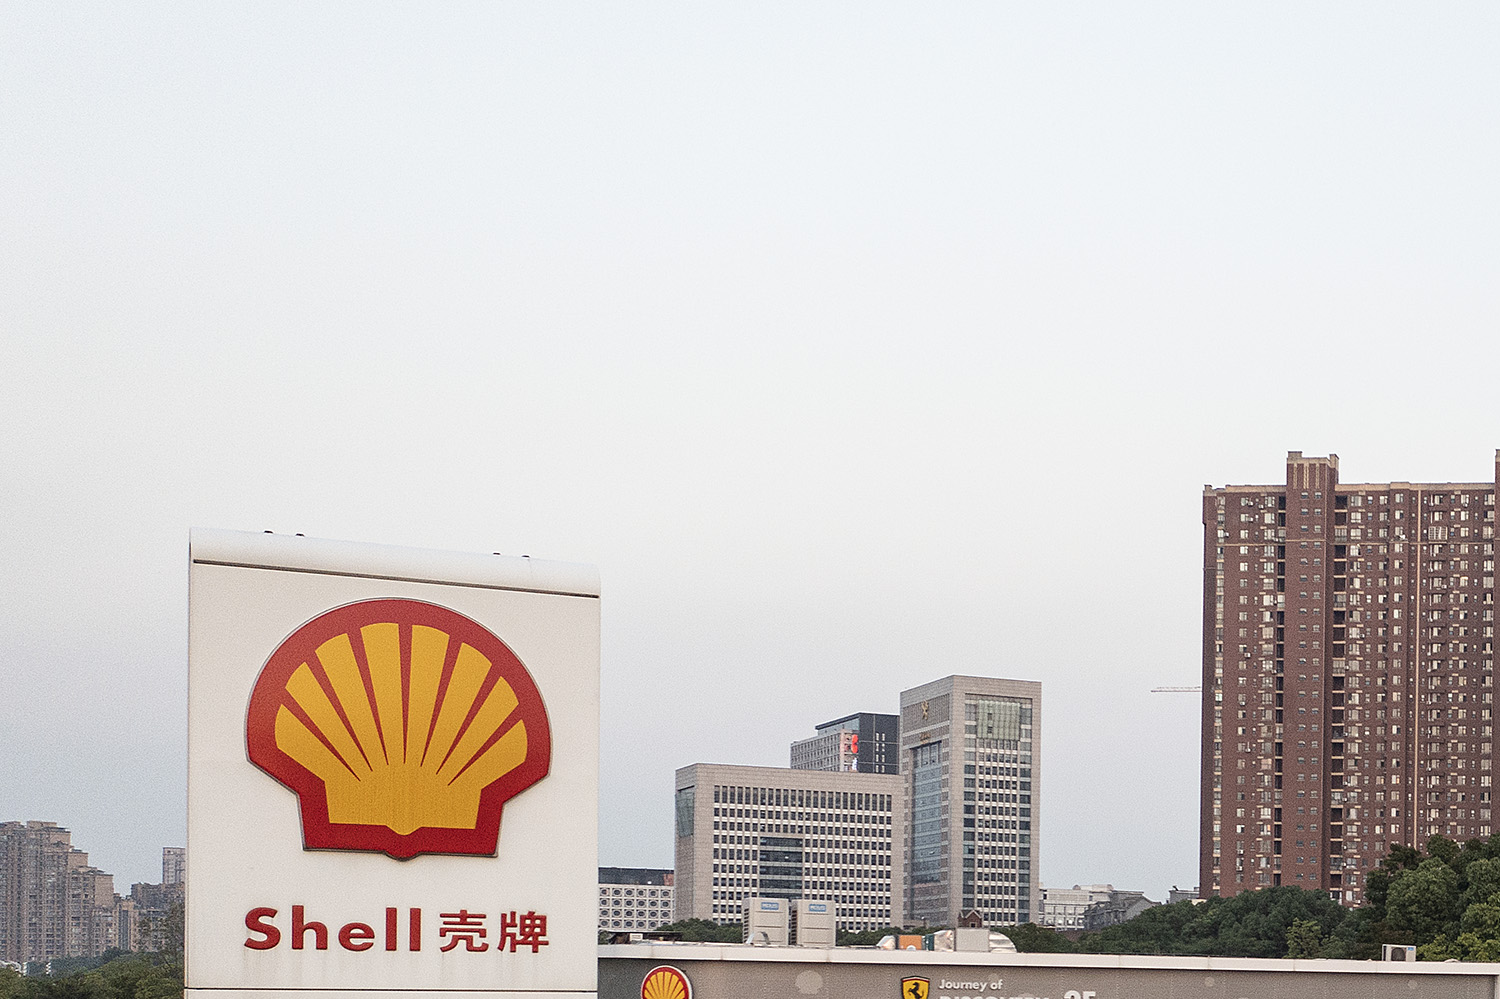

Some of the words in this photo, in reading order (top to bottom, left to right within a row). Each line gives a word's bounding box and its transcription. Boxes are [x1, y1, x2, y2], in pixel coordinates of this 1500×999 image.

[244, 905, 421, 951] Shell
[439, 909, 549, 953] 壳牌
[939, 979, 987, 992] Journey
[990, 979, 1003, 990] of
